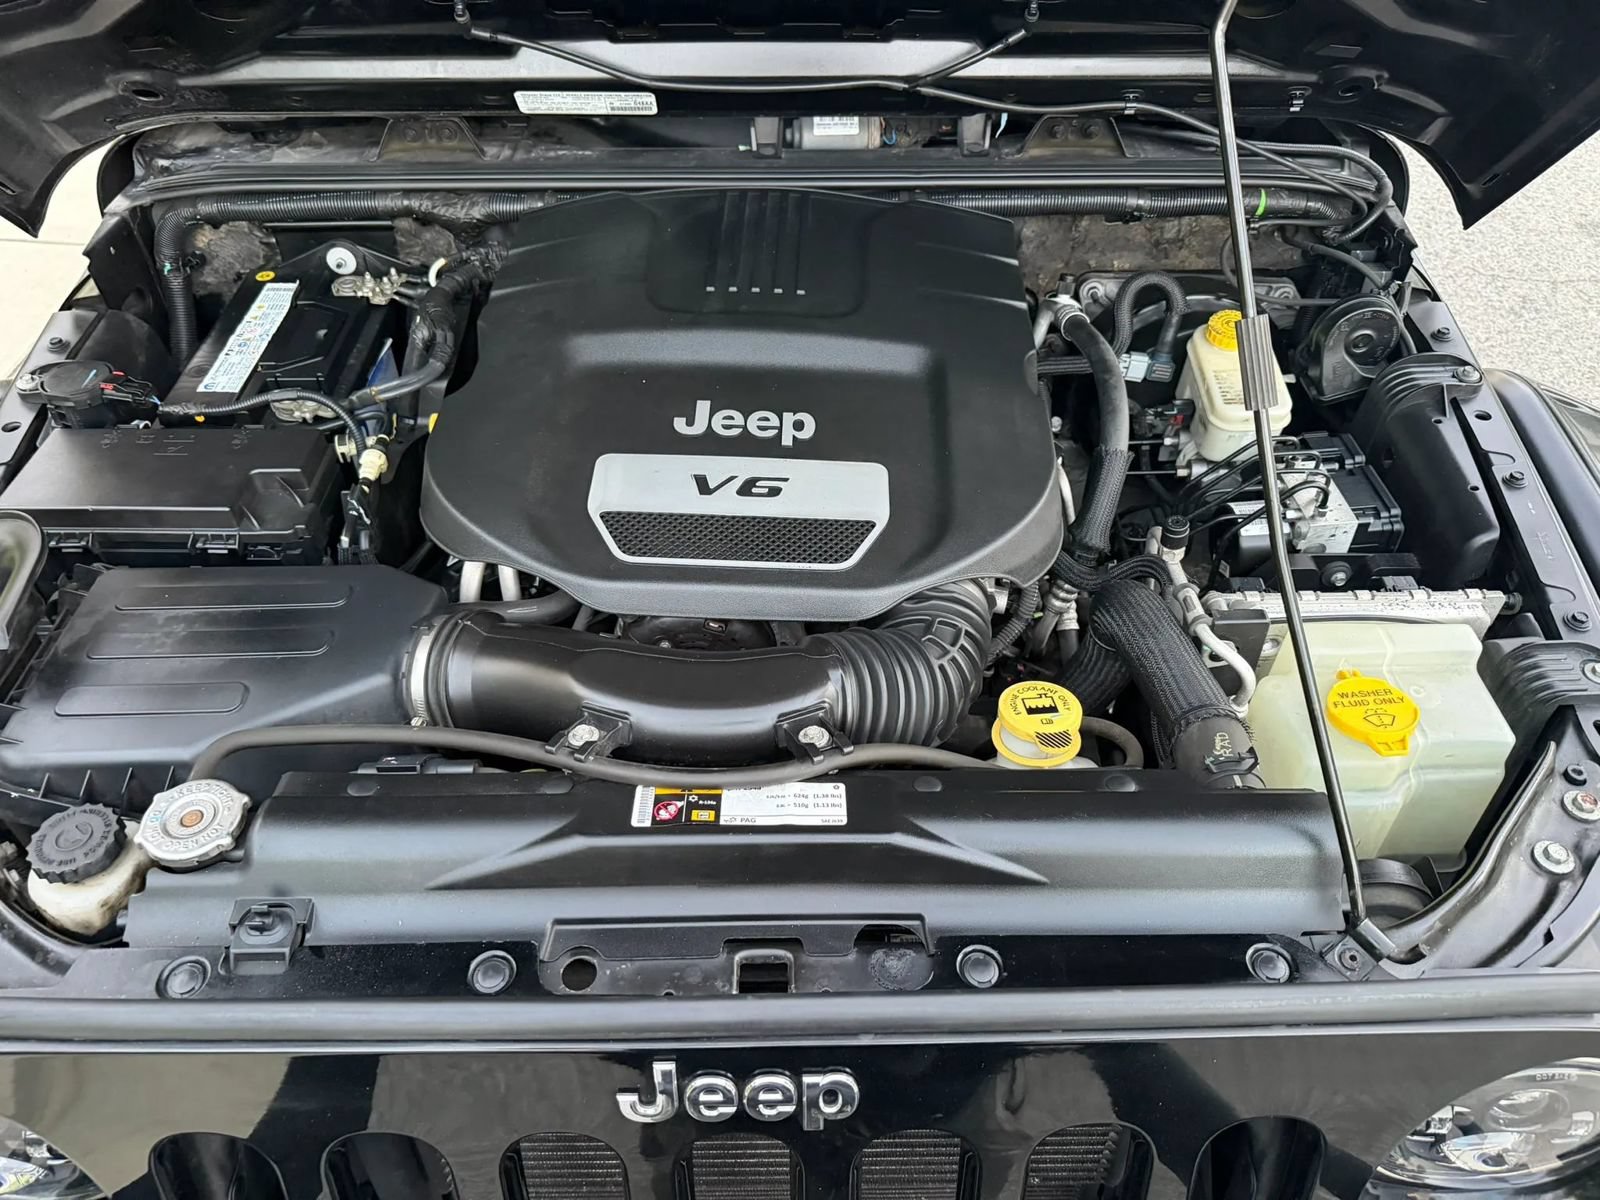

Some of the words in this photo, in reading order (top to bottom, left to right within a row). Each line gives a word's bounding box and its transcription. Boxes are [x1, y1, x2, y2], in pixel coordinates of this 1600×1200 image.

[673, 400, 816, 447] Jeep
[692, 474, 790, 498] V6
[1010, 694, 1021, 715] ENGINE
[1017, 685, 1058, 695] COOLANT
[1058, 694, 1072, 712] ONLY
[1333, 698, 1371, 709] FLUID
[1372, 696, 1405, 706] ONLY
[1337, 688, 1393, 699] WASHER
[176, 782, 211, 797] KEEP
[164, 838, 199, 850] OPEN
[616, 1056, 860, 1131] Jeep
